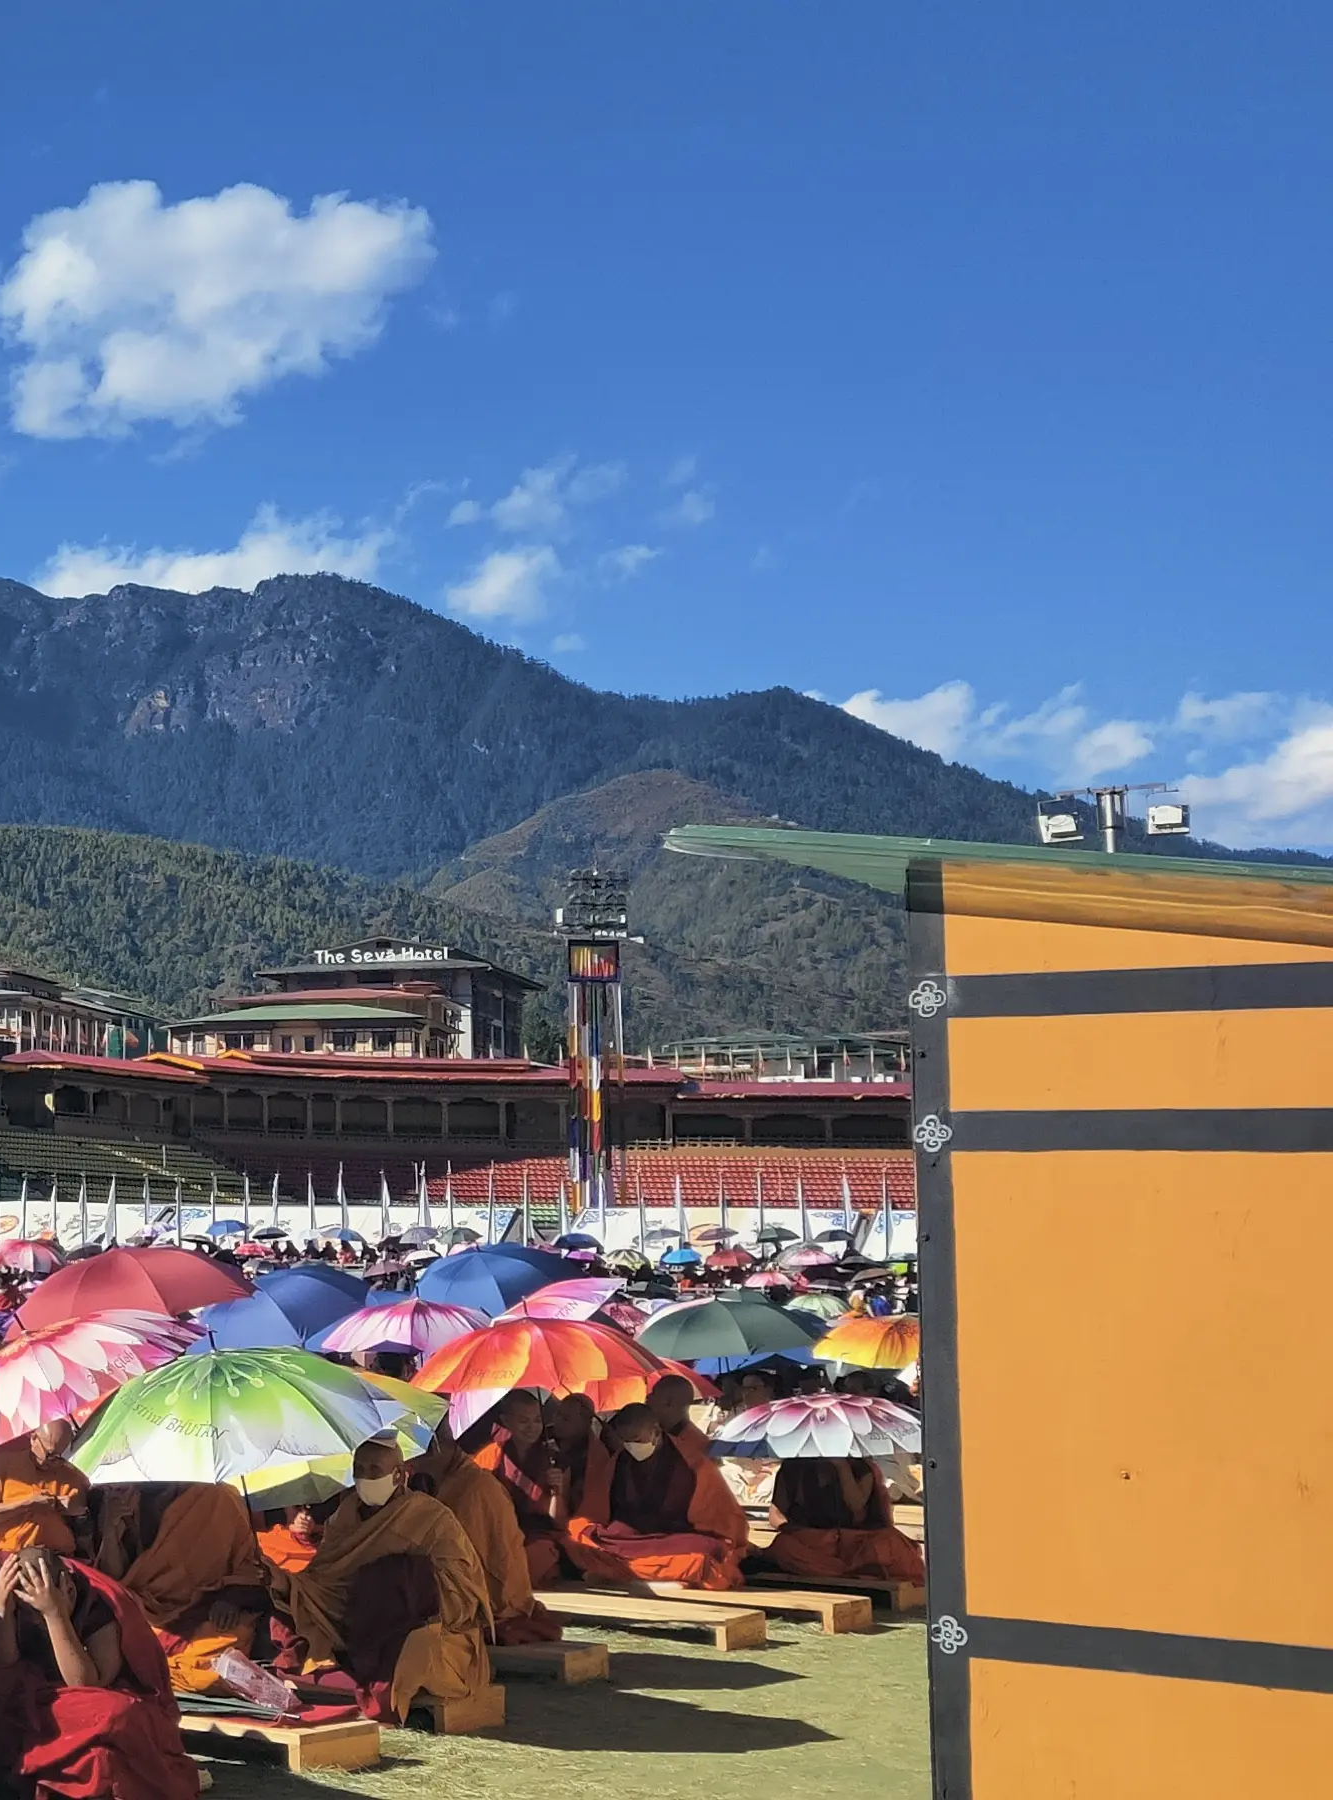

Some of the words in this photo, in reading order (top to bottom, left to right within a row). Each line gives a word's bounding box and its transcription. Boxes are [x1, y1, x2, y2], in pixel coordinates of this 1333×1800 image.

[314, 949, 345, 964] The
[401, 946, 449, 961] Hotel
[127, 1395, 173, 1426] stival
[166, 1416, 229, 1440] BHUTAN
